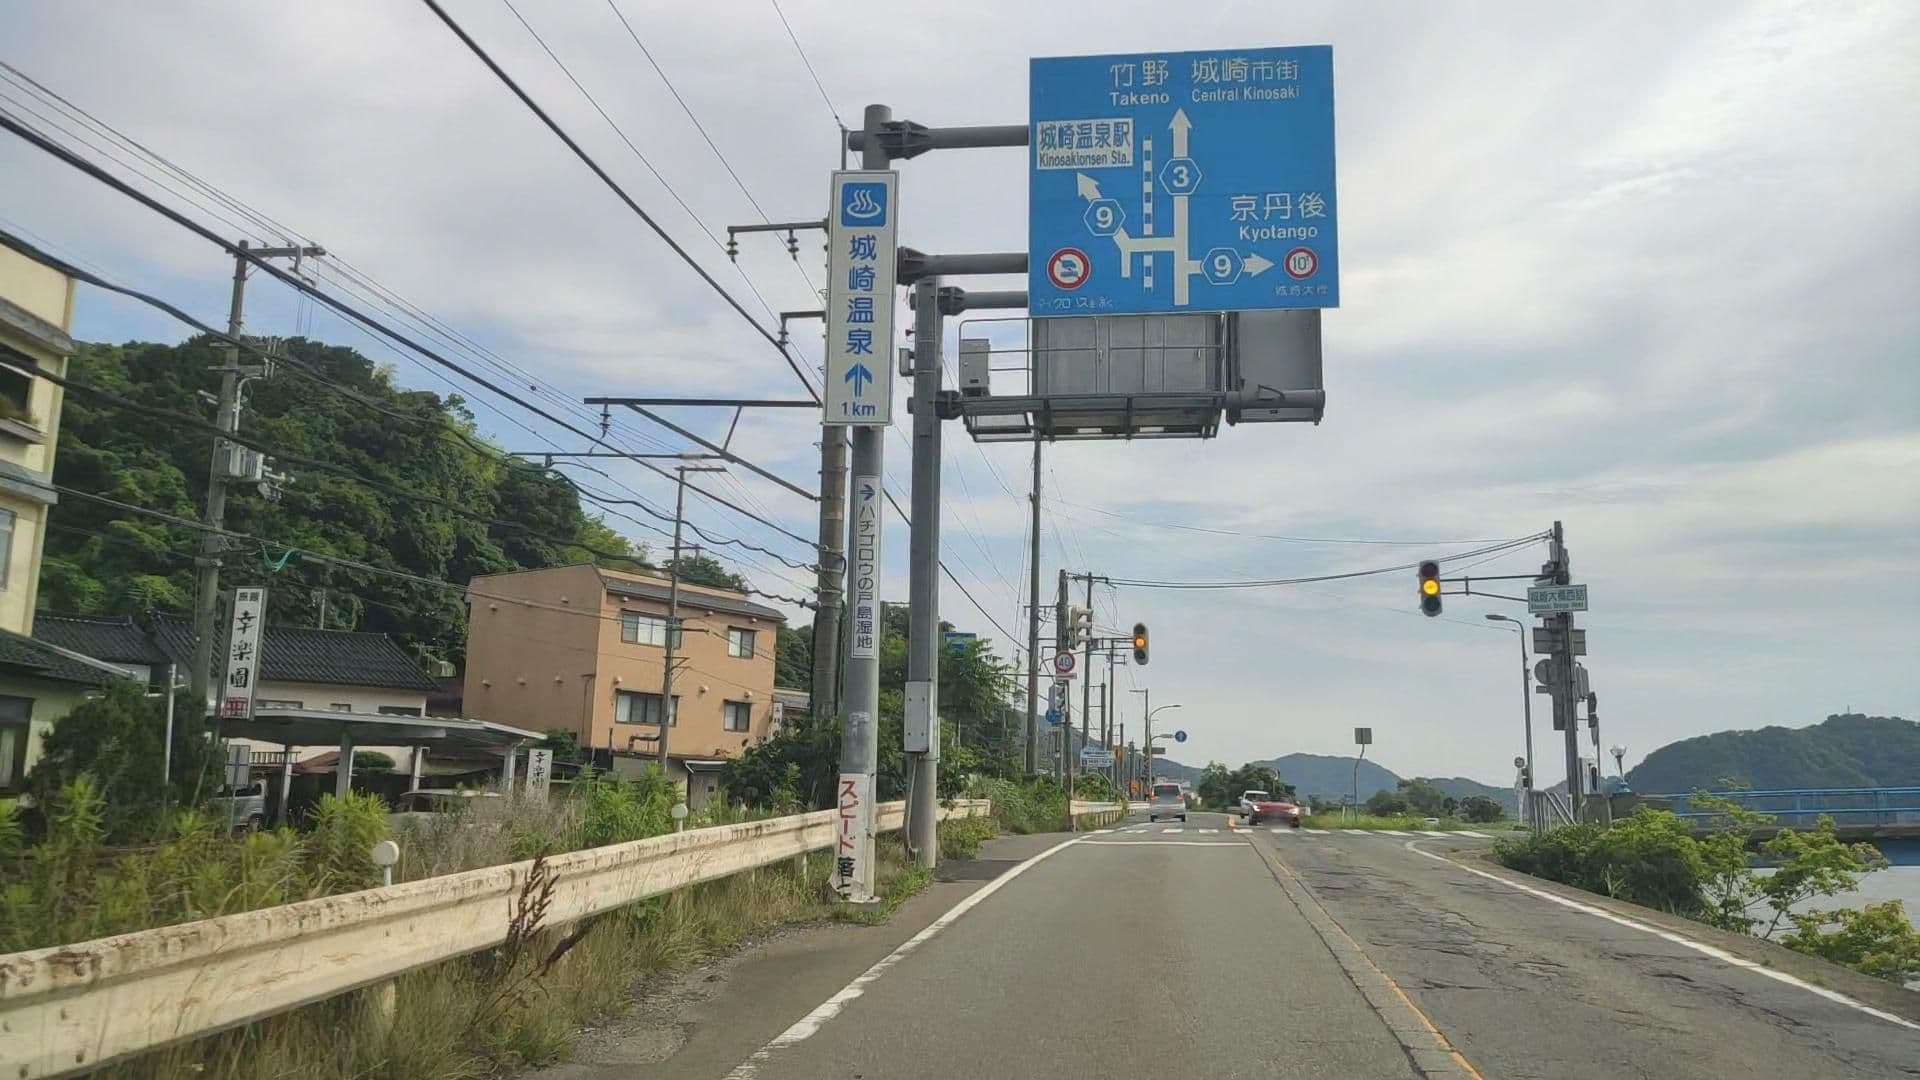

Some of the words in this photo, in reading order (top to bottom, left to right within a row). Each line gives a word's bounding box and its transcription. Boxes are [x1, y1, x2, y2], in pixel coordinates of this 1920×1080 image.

[1110, 91, 1169, 106] Takeno
[1191, 87, 1238, 102] Central
[1243, 85, 1300, 100] Kinosaki
[1039, 121, 1131, 151] 城崎温泉駅
[1111, 150, 1130, 165] Sta.
[1173, 165, 1190, 187] 3
[1096, 206, 1113, 228] 9
[1230, 192, 1327, 222] 京丹後
[1239, 226, 1318, 242] Kyotango
[1214, 255, 1231, 278] 9
[846, 235, 877, 355] 城崎温泉
[856, 505, 876, 649] ハチゴロウの戸島湿地
[1059, 656, 1071, 667] 40
